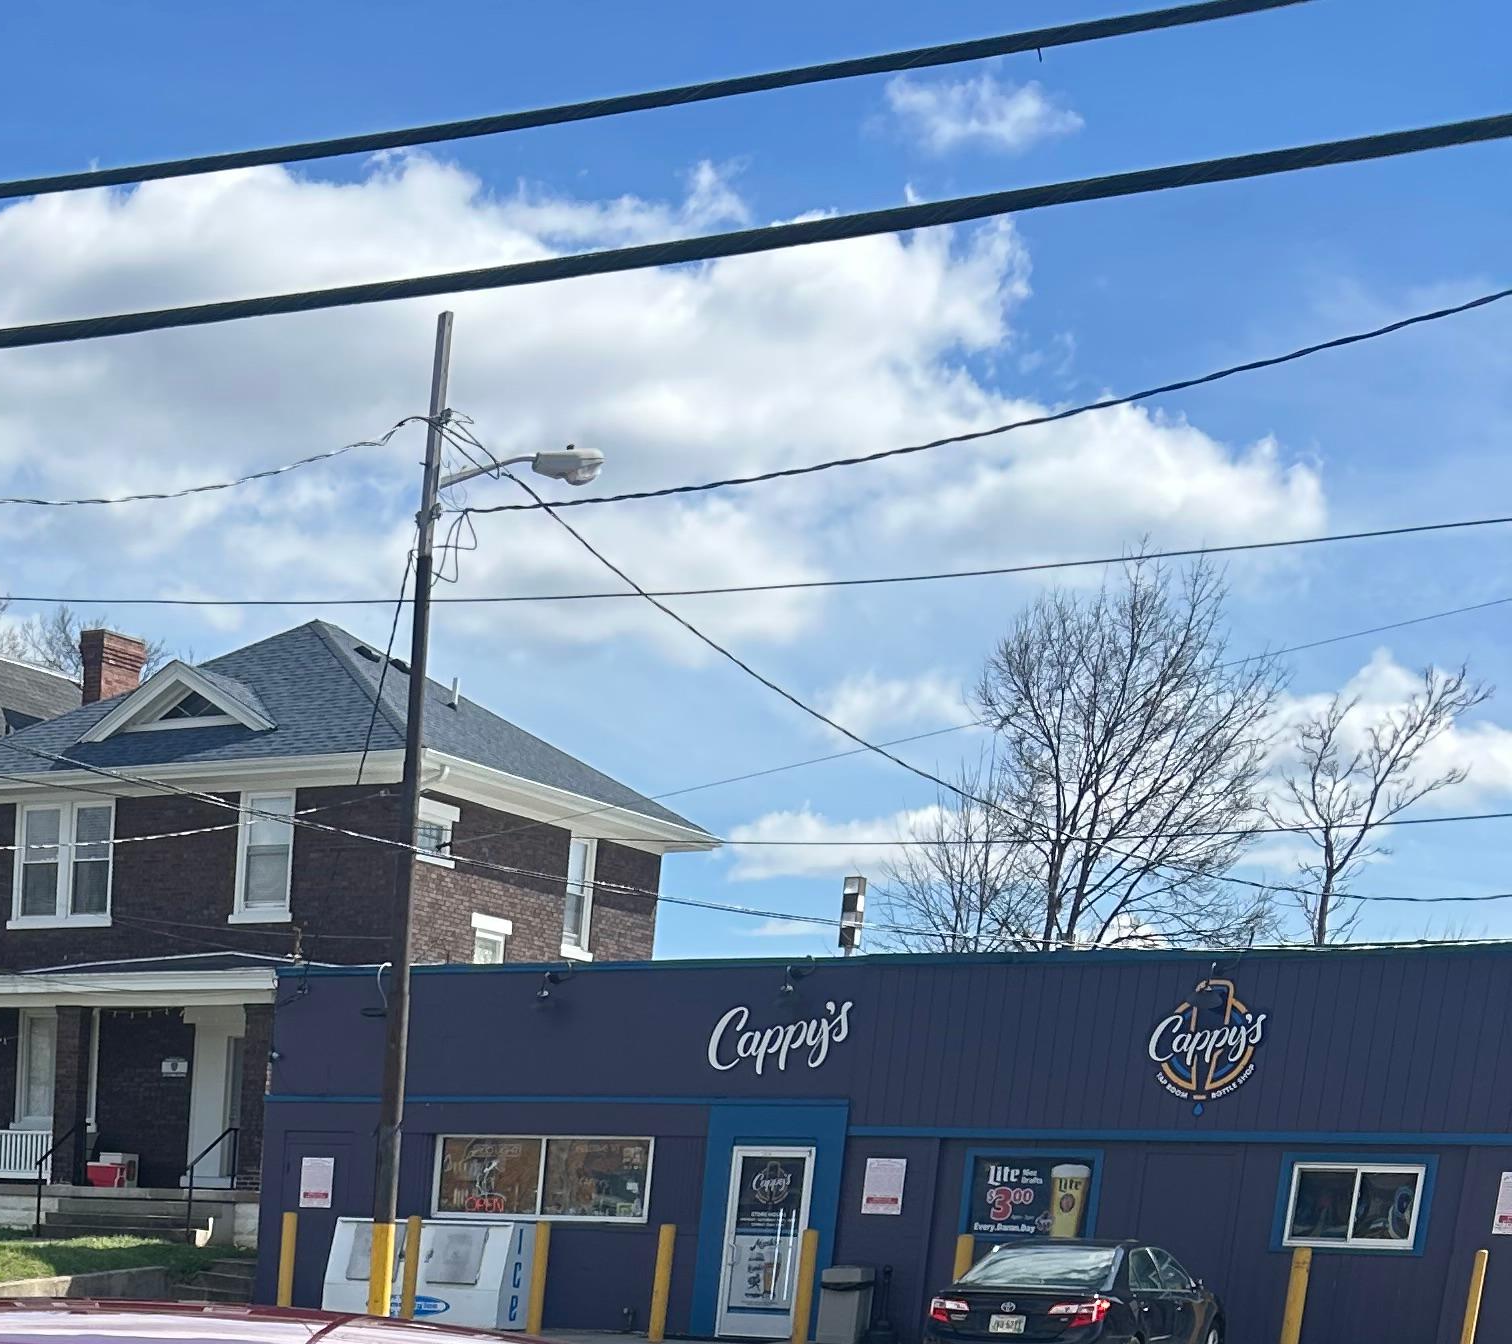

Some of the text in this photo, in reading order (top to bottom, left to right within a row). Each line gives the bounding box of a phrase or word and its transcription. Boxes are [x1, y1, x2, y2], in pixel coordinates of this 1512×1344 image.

[707, 1001, 853, 1075] Cappy's
[1148, 1014, 1267, 1066] Cappy's
[1156, 1071, 1189, 1099] TAP ROOM
[1211, 1063, 1255, 1099] BOTTLE SHOP
[752, 1173, 793, 1192] Cappy's
[988, 1165, 1020, 1186] Lite
[1058, 1178, 1083, 1193] Lite
[465, 1196, 506, 1213] OPEN
